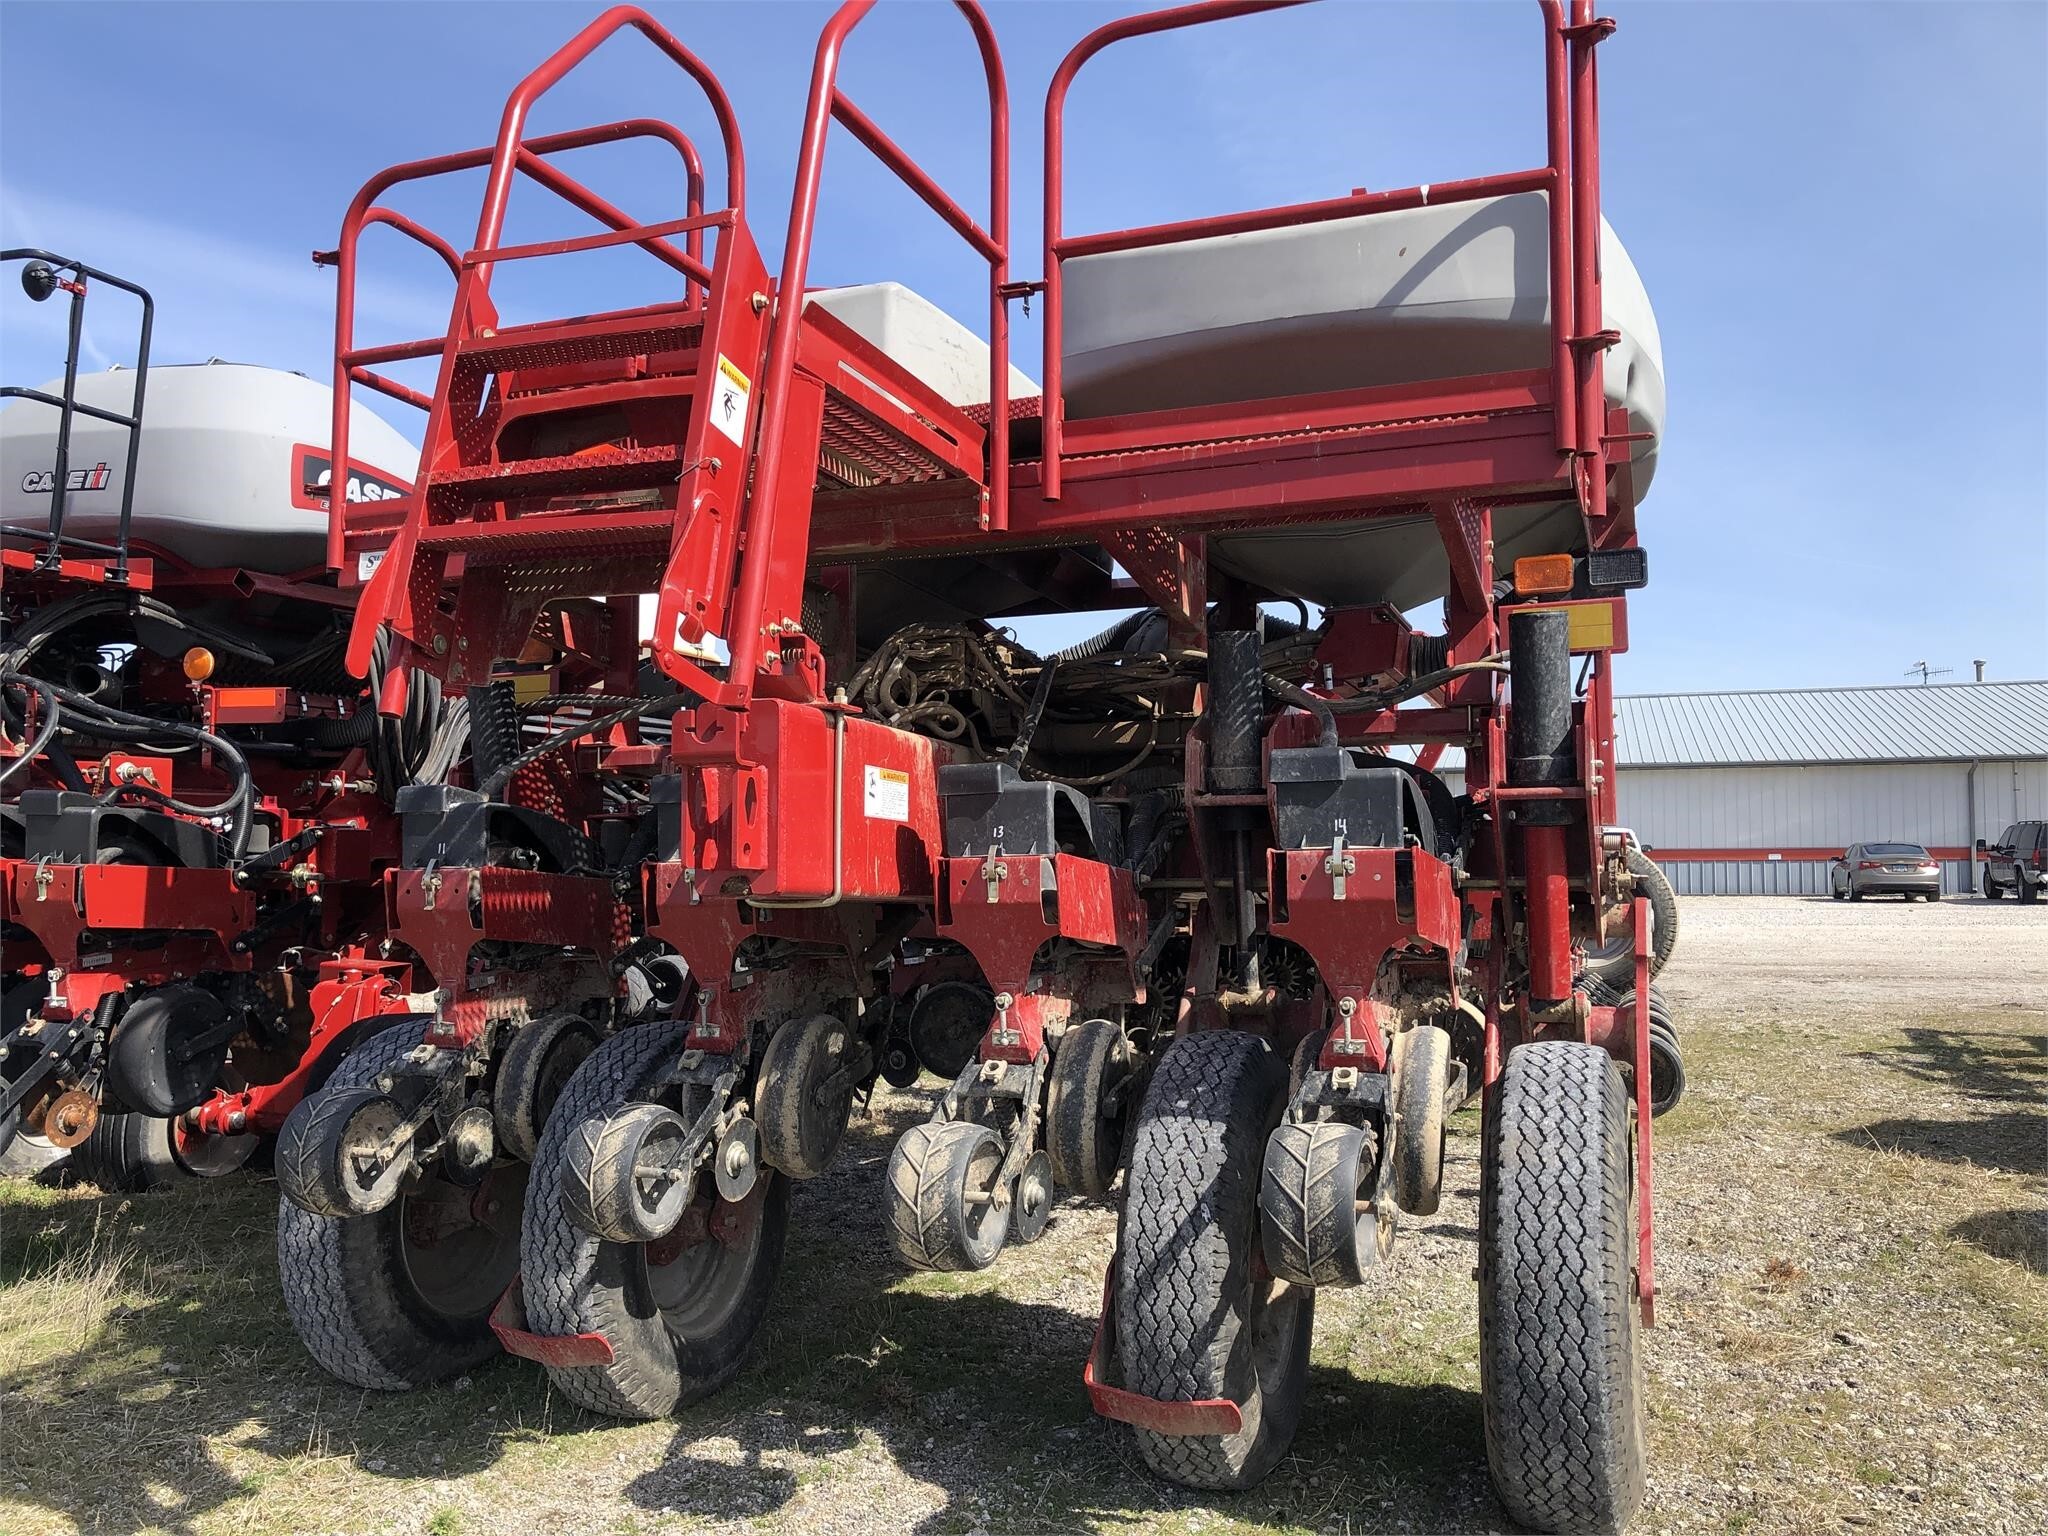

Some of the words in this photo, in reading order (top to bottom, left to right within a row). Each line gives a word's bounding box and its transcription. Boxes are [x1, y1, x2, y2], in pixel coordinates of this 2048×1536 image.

[22, 472, 86, 493] CAE
[993, 825, 1004, 838] 13
[1335, 818, 1347, 834] 14
